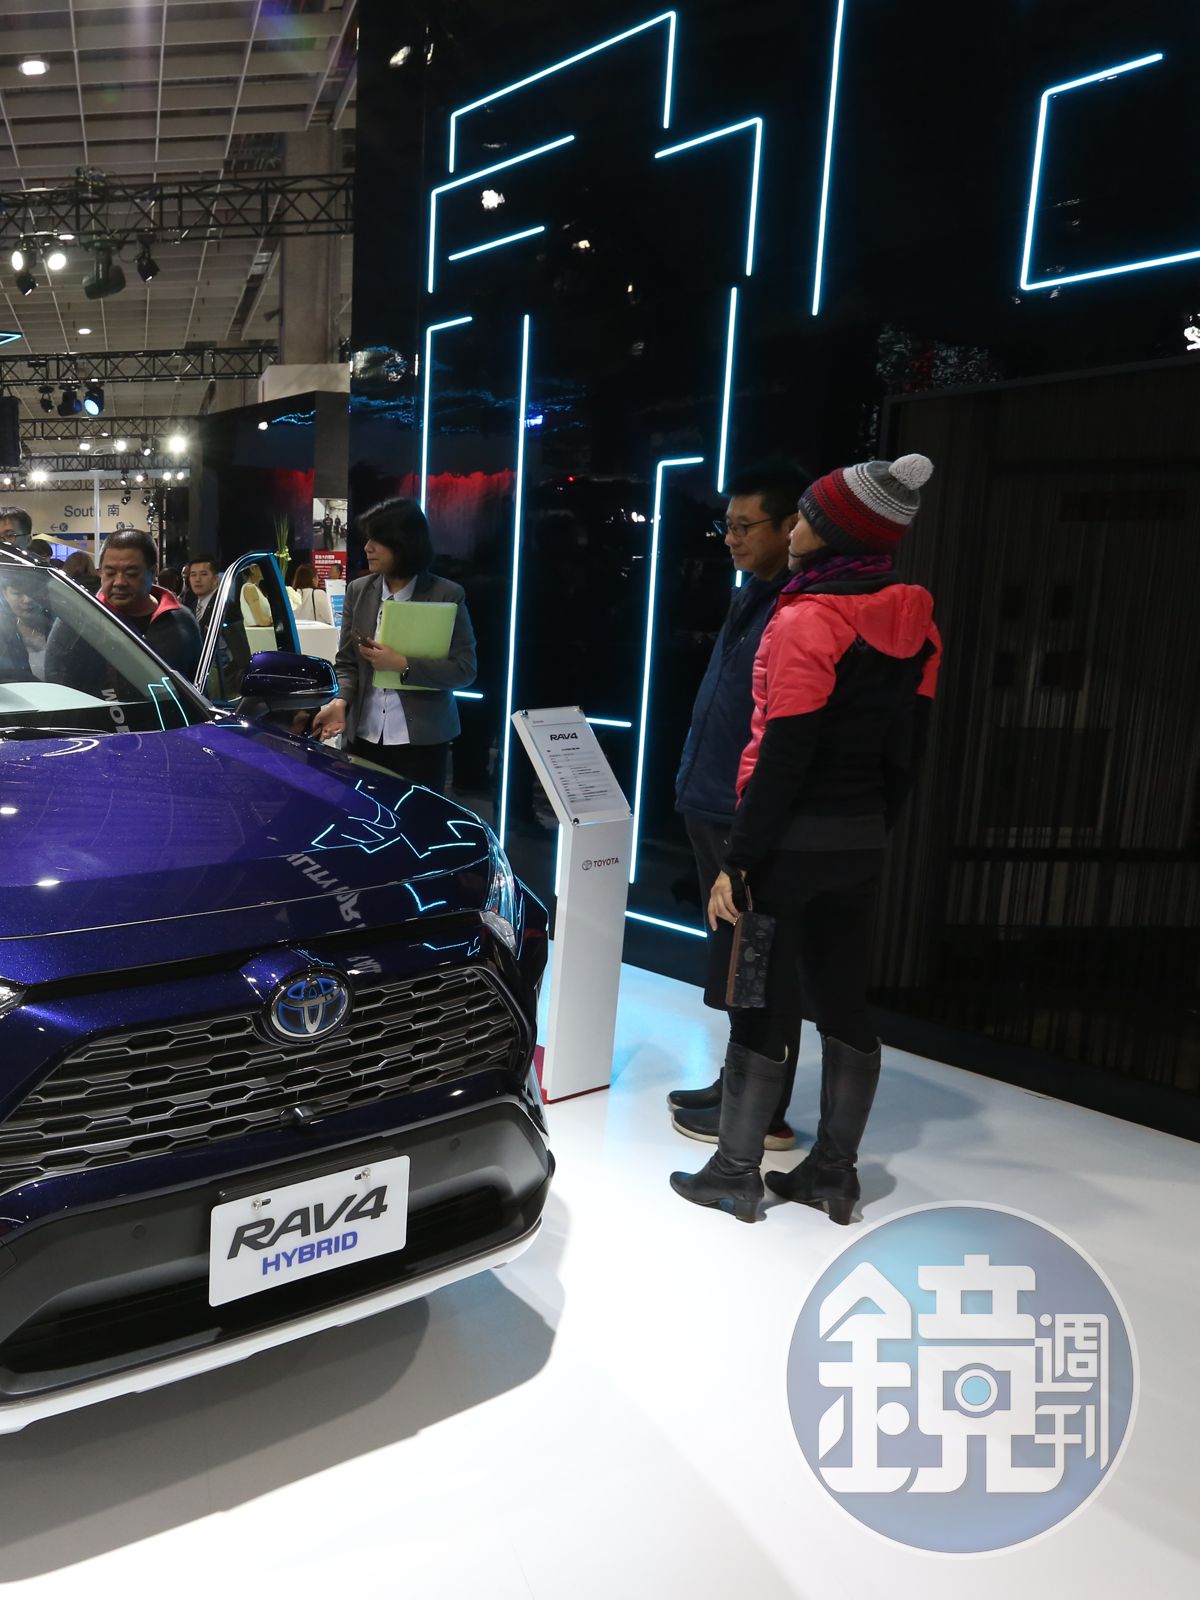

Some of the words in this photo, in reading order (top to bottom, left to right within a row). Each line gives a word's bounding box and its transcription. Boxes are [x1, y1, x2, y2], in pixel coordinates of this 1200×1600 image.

[107, 504, 120, 517] 南
[550, 732, 578, 741] RAV4
[593, 857, 620, 868] TOYOTA
[227, 1185, 388, 1260] RAV4
[262, 1231, 358, 1276] HYBRID
